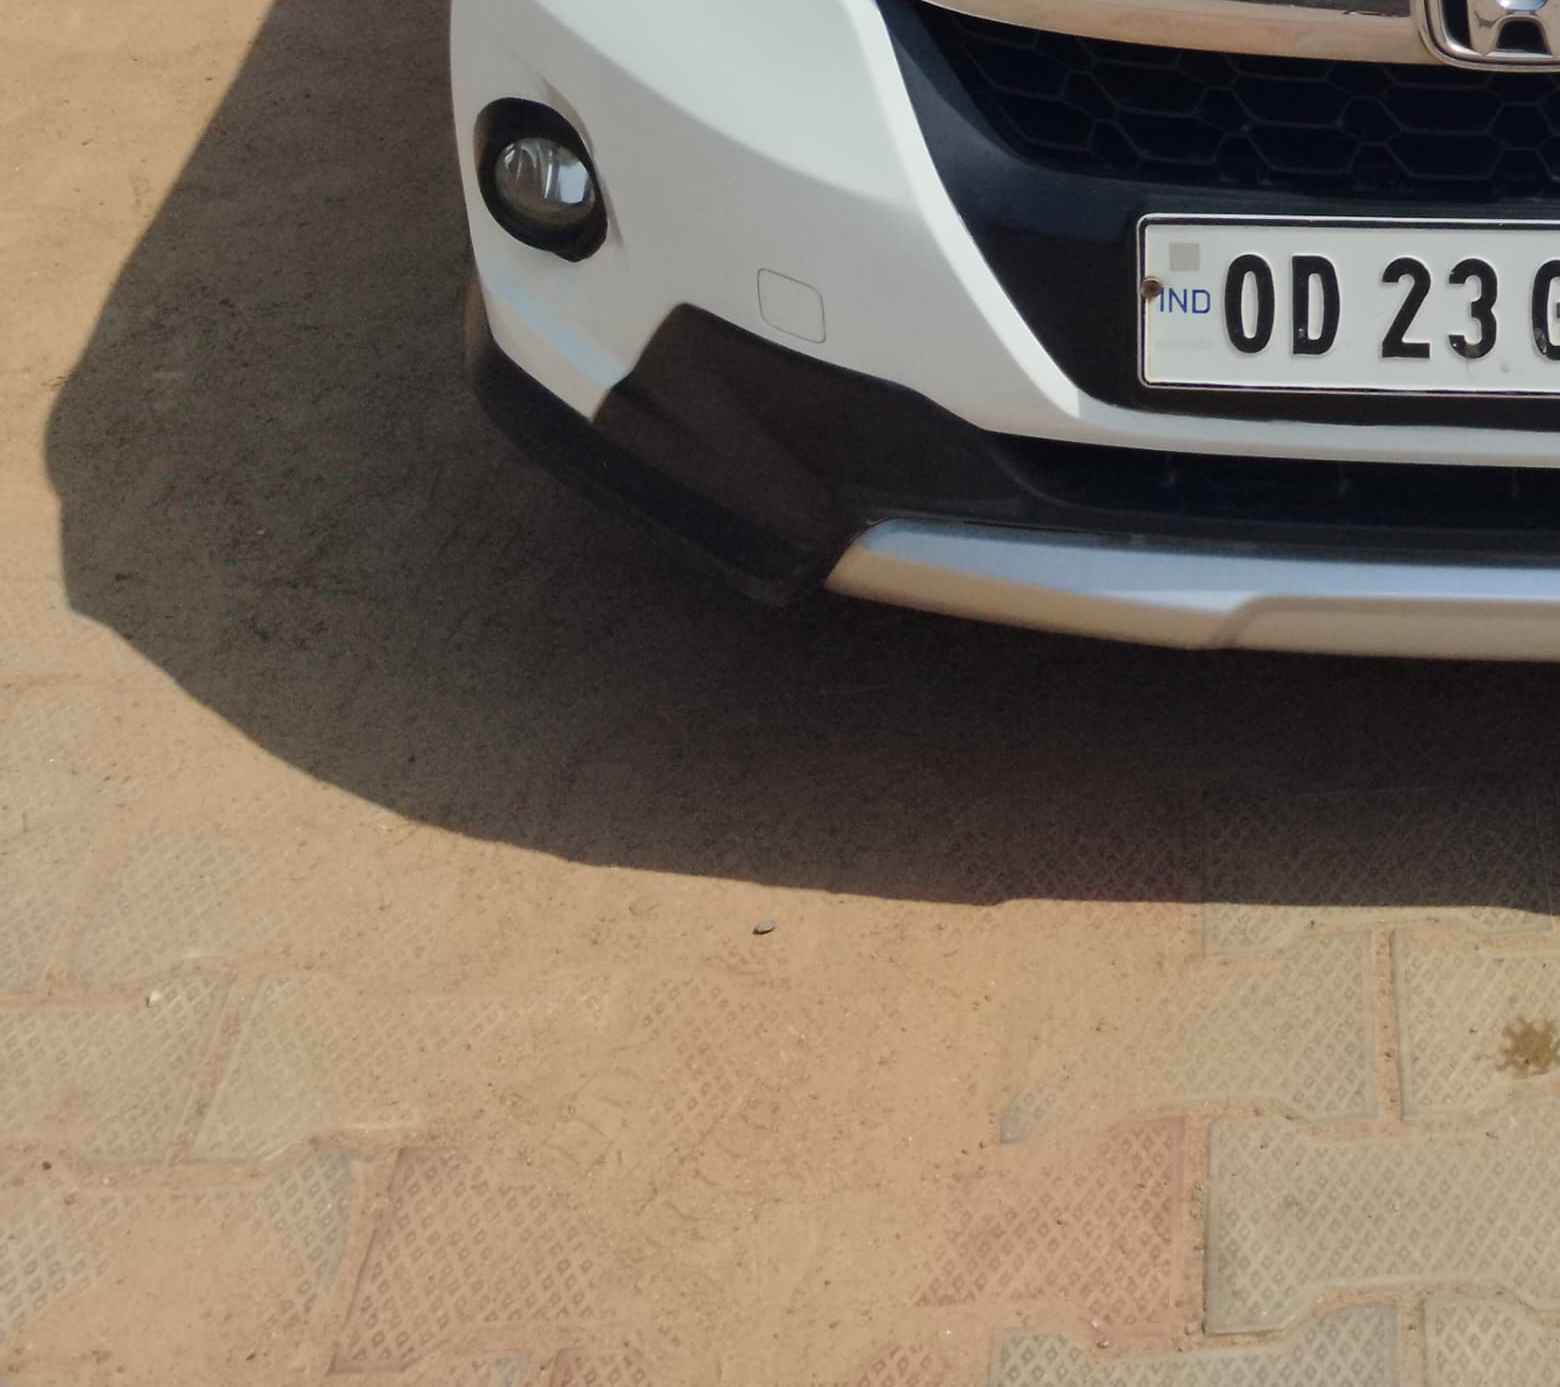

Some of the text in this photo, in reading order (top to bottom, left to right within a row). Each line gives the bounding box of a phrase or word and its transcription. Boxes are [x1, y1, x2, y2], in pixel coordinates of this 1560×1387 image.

[1159, 287, 1212, 315] IND
[1224, 254, 1340, 355] OD
[1381, 257, 1498, 359] 23
